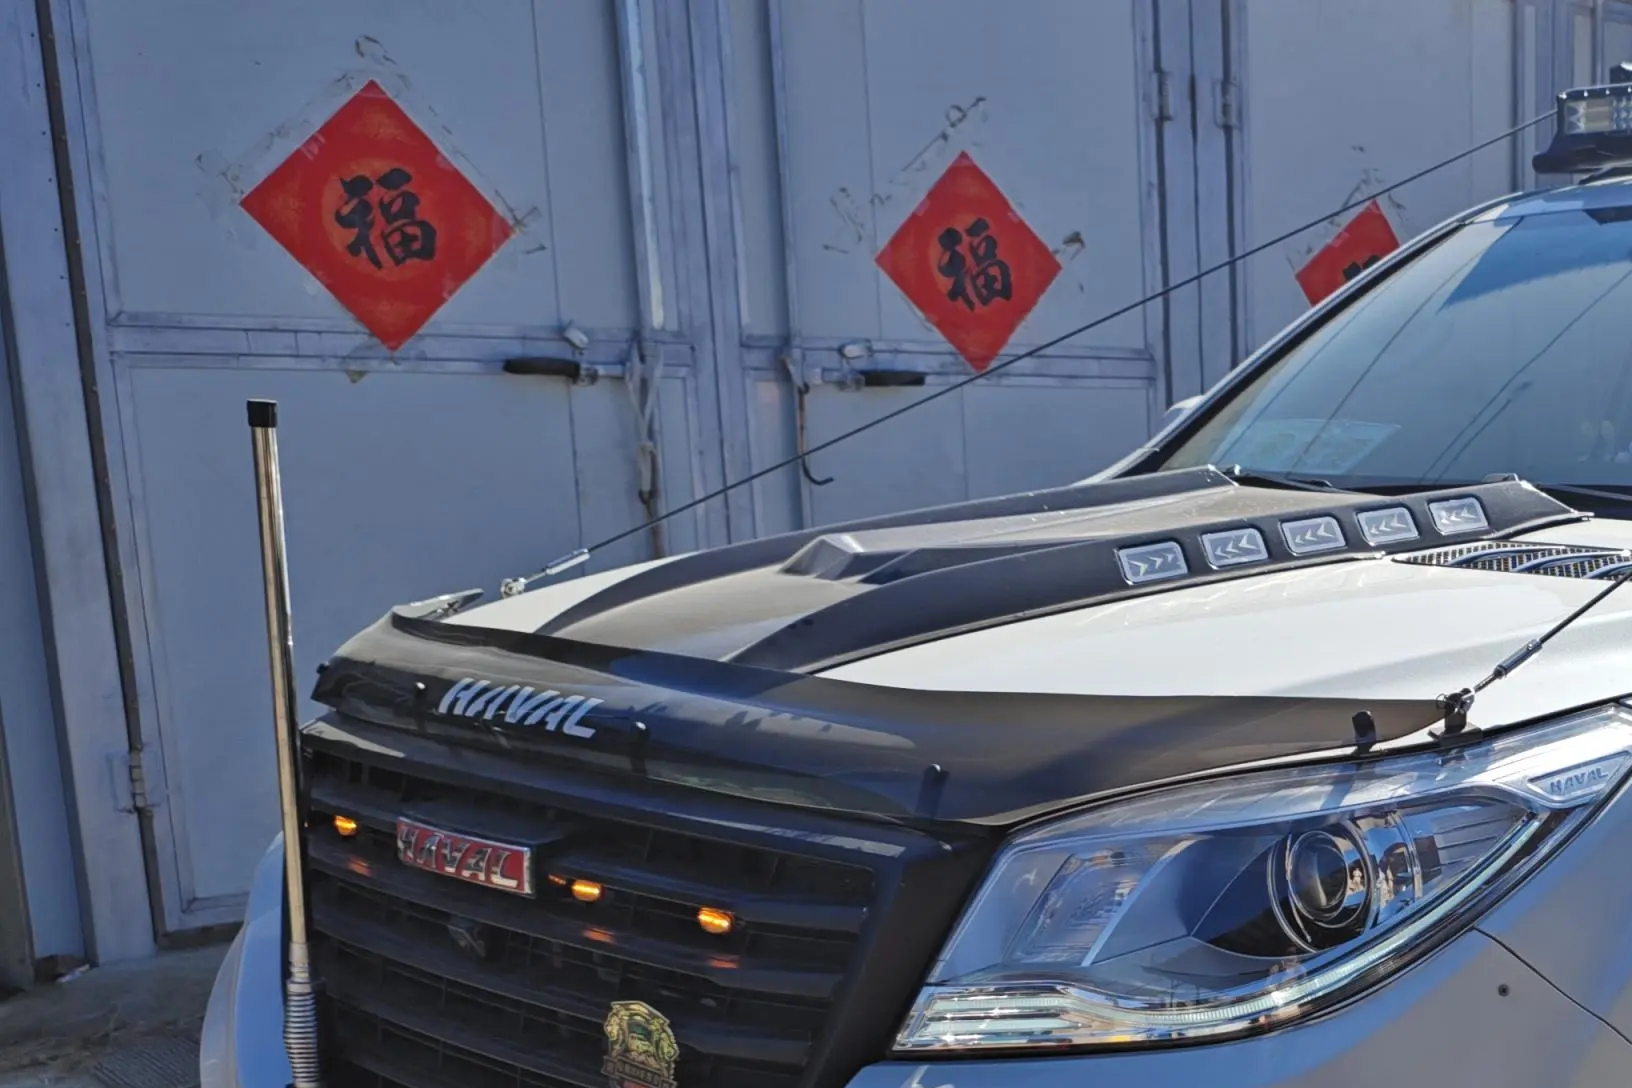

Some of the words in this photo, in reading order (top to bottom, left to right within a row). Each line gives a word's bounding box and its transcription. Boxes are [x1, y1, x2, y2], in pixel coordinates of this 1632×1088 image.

[335, 168, 436, 269] 福
[938, 218, 1011, 312] 福
[438, 677, 605, 739] HAVAL
[1548, 767, 1609, 795] HAVAL
[397, 825, 519, 889] HAVAL
